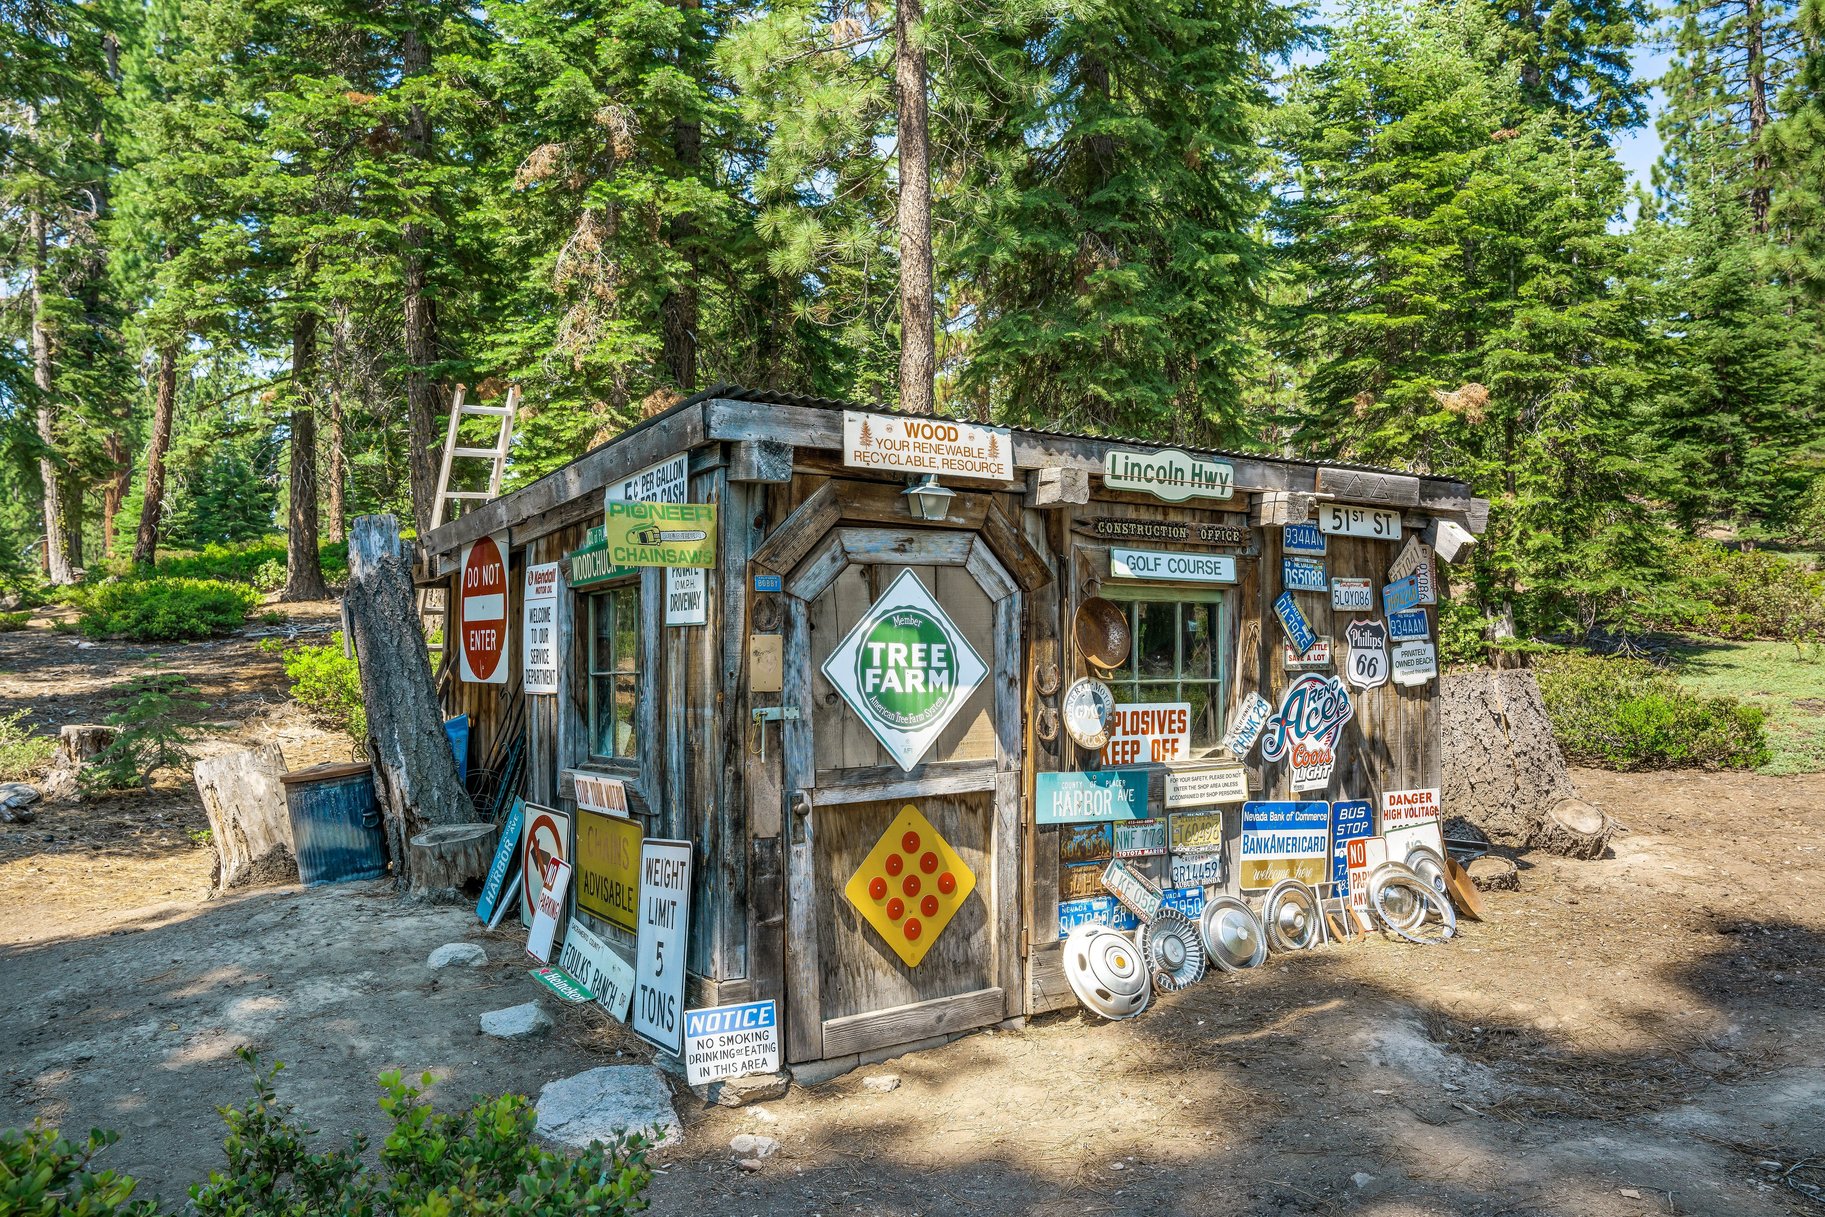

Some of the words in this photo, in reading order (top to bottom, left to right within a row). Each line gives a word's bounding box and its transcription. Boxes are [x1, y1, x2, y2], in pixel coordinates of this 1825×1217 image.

[904, 422, 958, 442] WOOD
[876, 438, 910, 452] YOUR
[854, 450, 939, 470] RECYCLABLE,
[941, 459, 1004, 475] RESOURCE
[641, 472, 655, 494] PER
[656, 459, 684, 487] GALLON
[1111, 454, 1185, 487] Lincoln
[1191, 463, 1230, 496] Hwy
[661, 481, 685, 503] CASH
[609, 502, 712, 521] PIONEER
[1098, 521, 1187, 538] CONSTRUCTION
[1200, 529, 1240, 542] OFFICE
[1374, 512, 1392, 535] ST
[1286, 527, 1323, 545] 934AAN
[614, 547, 713, 564] CHAINSAWS
[1126, 555, 1161, 572] GOLF
[1168, 557, 1222, 576] COURSE
[467, 567, 479, 588] DO
[482, 563, 500, 586] NOT
[533, 568, 557, 585] Kendall
[670, 591, 701, 612] DRIVEWAY
[529, 607, 551, 624] WELCOME
[893, 615, 922, 628] Member
[469, 629, 497, 651] ENTER
[531, 628, 538, 644] TO
[539, 628, 549, 643] OUR
[1350, 628, 1382, 650] Phillips
[530, 649, 549, 664] SERVICE
[867, 642, 947, 667] TREE
[1395, 660, 1415, 668] OWNED
[1416, 657, 1433, 665] BEACH
[1401, 648, 1426, 658] PRIVATELY
[525, 669, 556, 685] DEPARTMENT
[1356, 654, 1378, 678] 66
[865, 669, 949, 693] FARM
[1307, 680, 1339, 708] RENO
[869, 695, 895, 721] American
[895, 711, 908, 724] Tree
[909, 713, 924, 724] Farm
[924, 696, 944, 718] System
[1264, 686, 1350, 755] Aces
[1113, 709, 1187, 736] PLOSIVES
[1101, 740, 1140, 765] KEEP
[1152, 738, 1179, 762] OFF
[1292, 743, 1332, 768] Coors
[1062, 781, 1082, 789] COUNTY
[1105, 779, 1126, 787] PLACER
[1295, 764, 1331, 782] LIGHT
[576, 779, 589, 804] STOP
[589, 781, 606, 807] YOUR
[1053, 789, 1113, 817] HARBOR
[1117, 789, 1135, 802] AVE
[1169, 793, 1199, 801] ACCOMPANIED
[1389, 792, 1433, 806] DANGER
[1244, 811, 1268, 822] Nevada
[1269, 811, 1284, 822] Bank
[1286, 811, 1294, 821] of
[1295, 811, 1328, 822] Commerce
[1340, 807, 1366, 820] BUS
[1383, 809, 1402, 821] HIGH
[1116, 830, 1137, 851] NWF
[1141, 829, 1164, 847] 773
[1336, 822, 1369, 836] STOP
[587, 826, 630, 870] CHAINS
[1350, 843, 1365, 865] NO
[485, 838, 514, 905] HARBOR
[510, 814, 519, 833] AVE
[1253, 862, 1290, 881] welcome
[1295, 860, 1313, 879] here
[545, 863, 557, 887] NO
[645, 857, 687, 891] WEIGHT
[1173, 862, 1217, 882] 3R14459
[584, 870, 634, 913] ADVISABLE
[1134, 889, 1157, 914] 058
[537, 893, 560, 920] PARKING
[648, 896, 677, 931] LIMIT
[571, 922, 589, 942] SACRAMENTO
[589, 937, 601, 952] COUNTY
[654, 940, 665, 977] 5
[563, 942, 592, 986] FOULKS
[590, 968, 619, 1012] RANCH
[640, 984, 675, 1034] TONS
[689, 1006, 772, 1035] NOTICE
[697, 1038, 714, 1051] NO
[719, 1030, 769, 1047] SMOKING
[689, 1048, 735, 1065] DRINKING
[736, 1048, 744, 1056] or
[745, 1042, 776, 1057] EATING
[699, 1066, 710, 1078] IN
[714, 1062, 738, 1076] THIS
[740, 1057, 768, 1072] AREA
